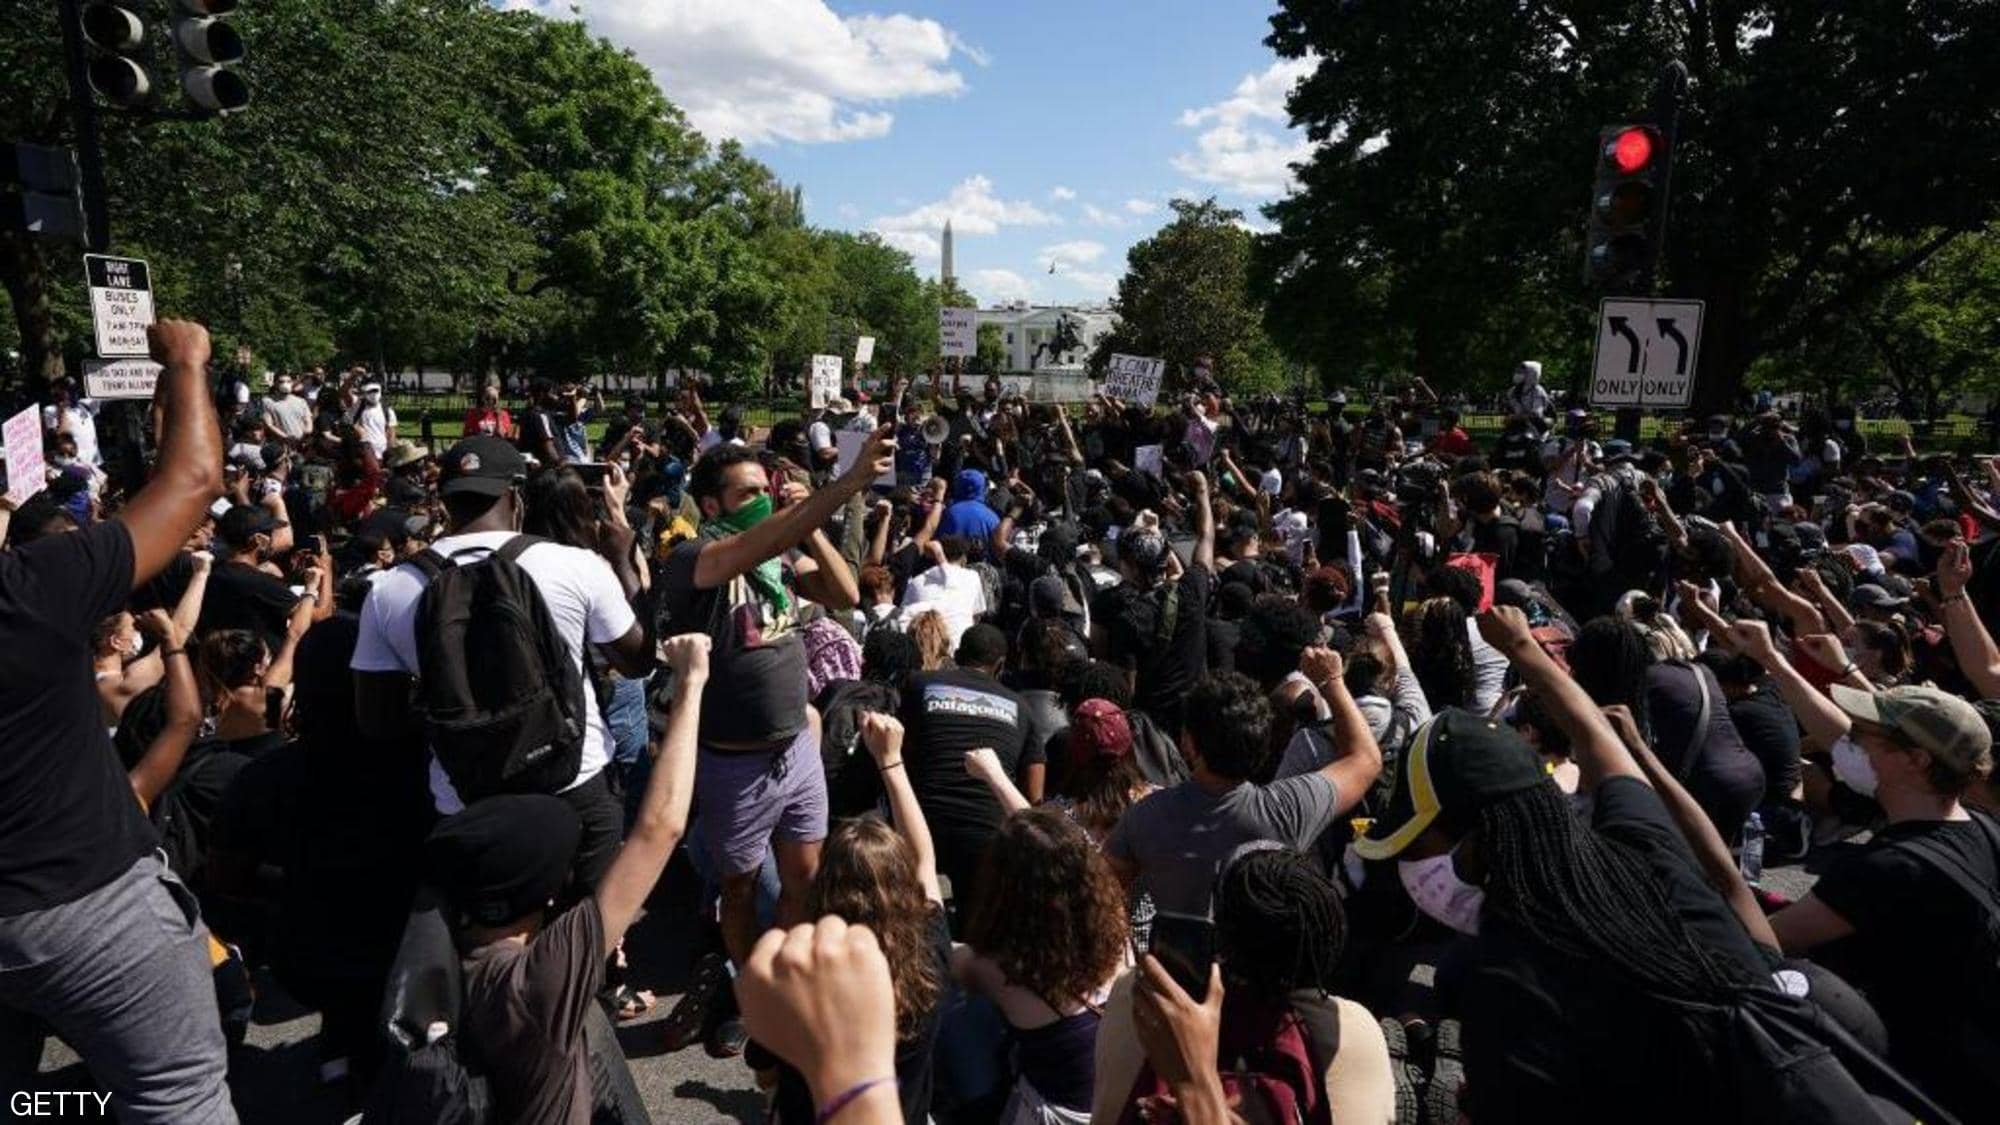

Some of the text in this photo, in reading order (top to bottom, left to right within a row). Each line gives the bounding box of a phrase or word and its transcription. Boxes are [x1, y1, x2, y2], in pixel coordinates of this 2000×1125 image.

[106, 274, 132, 288] LANE
[105, 291, 139, 303] BUSES
[111, 304, 136, 317] ONLY
[1596, 379, 1687, 395] ONLY ONLY
